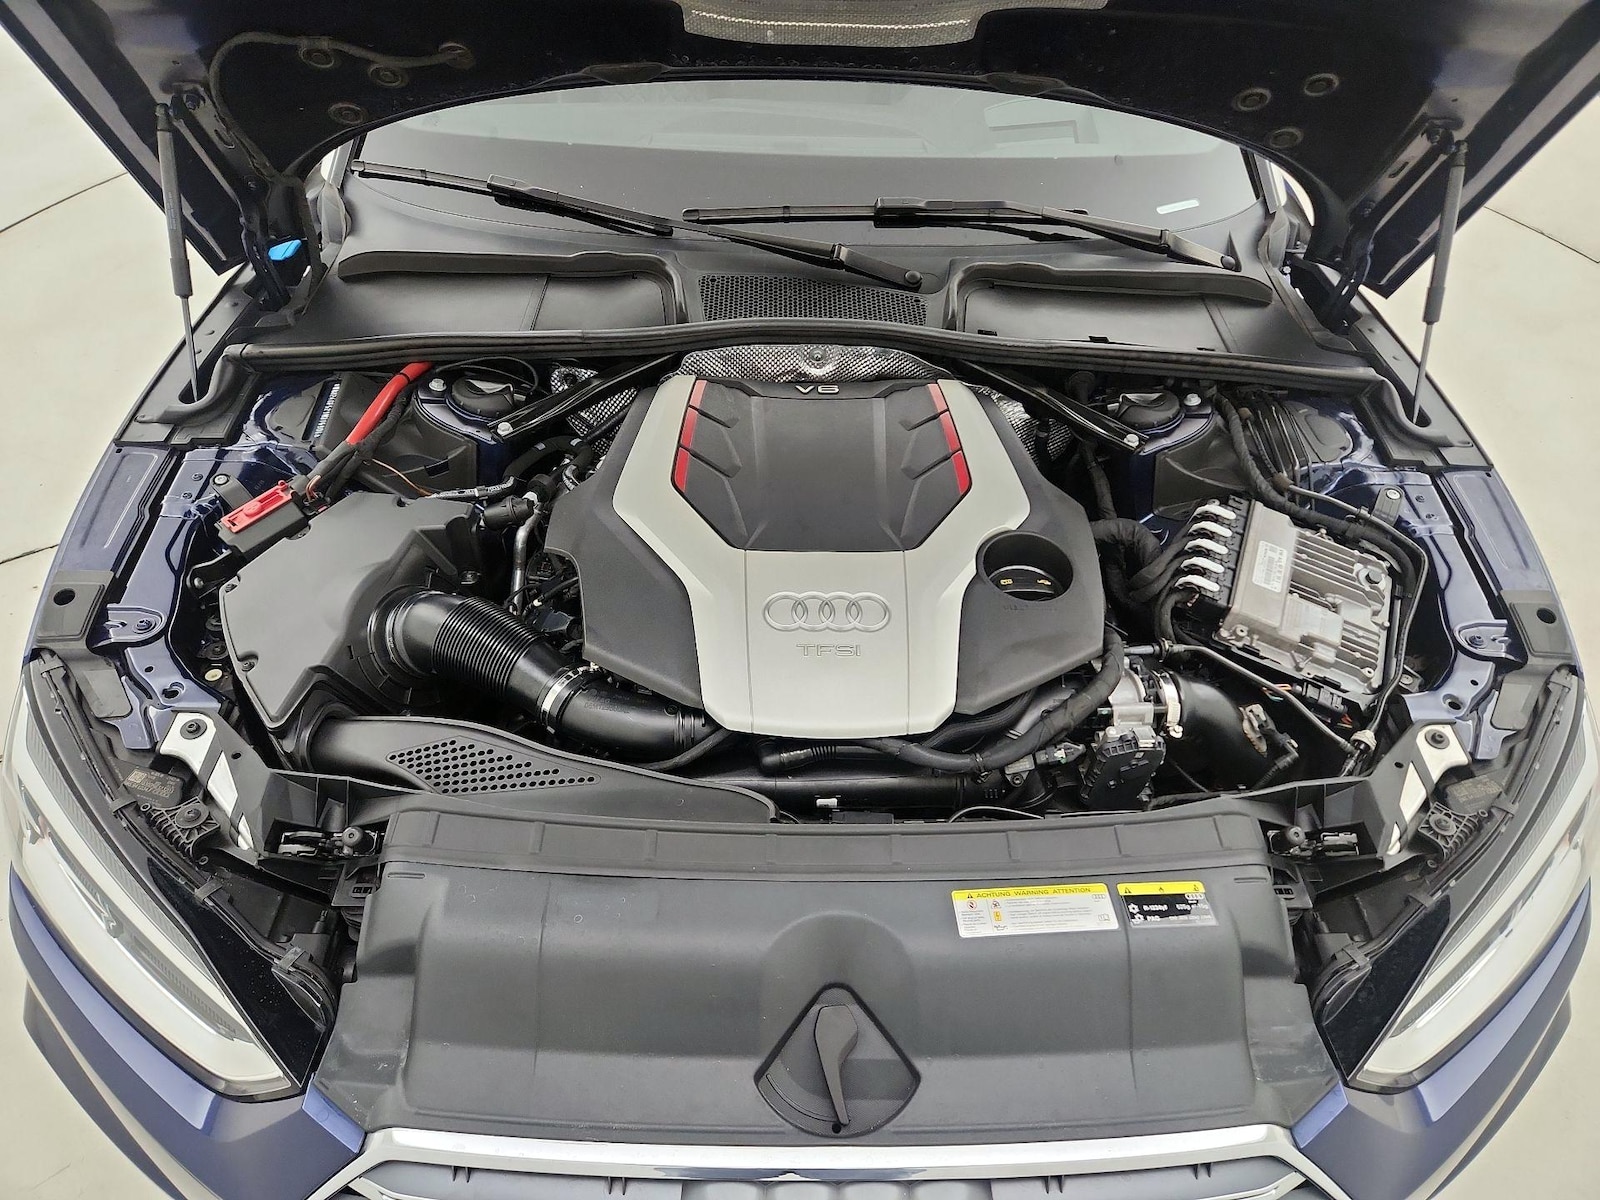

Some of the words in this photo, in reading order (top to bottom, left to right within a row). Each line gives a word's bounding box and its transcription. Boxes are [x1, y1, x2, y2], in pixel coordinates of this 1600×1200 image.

[795, 384, 840, 394] V6
[796, 643, 861, 657] TFSI
[976, 891, 1011, 899] ACHTUNG
[1052, 887, 1091, 895] ATTENTION
